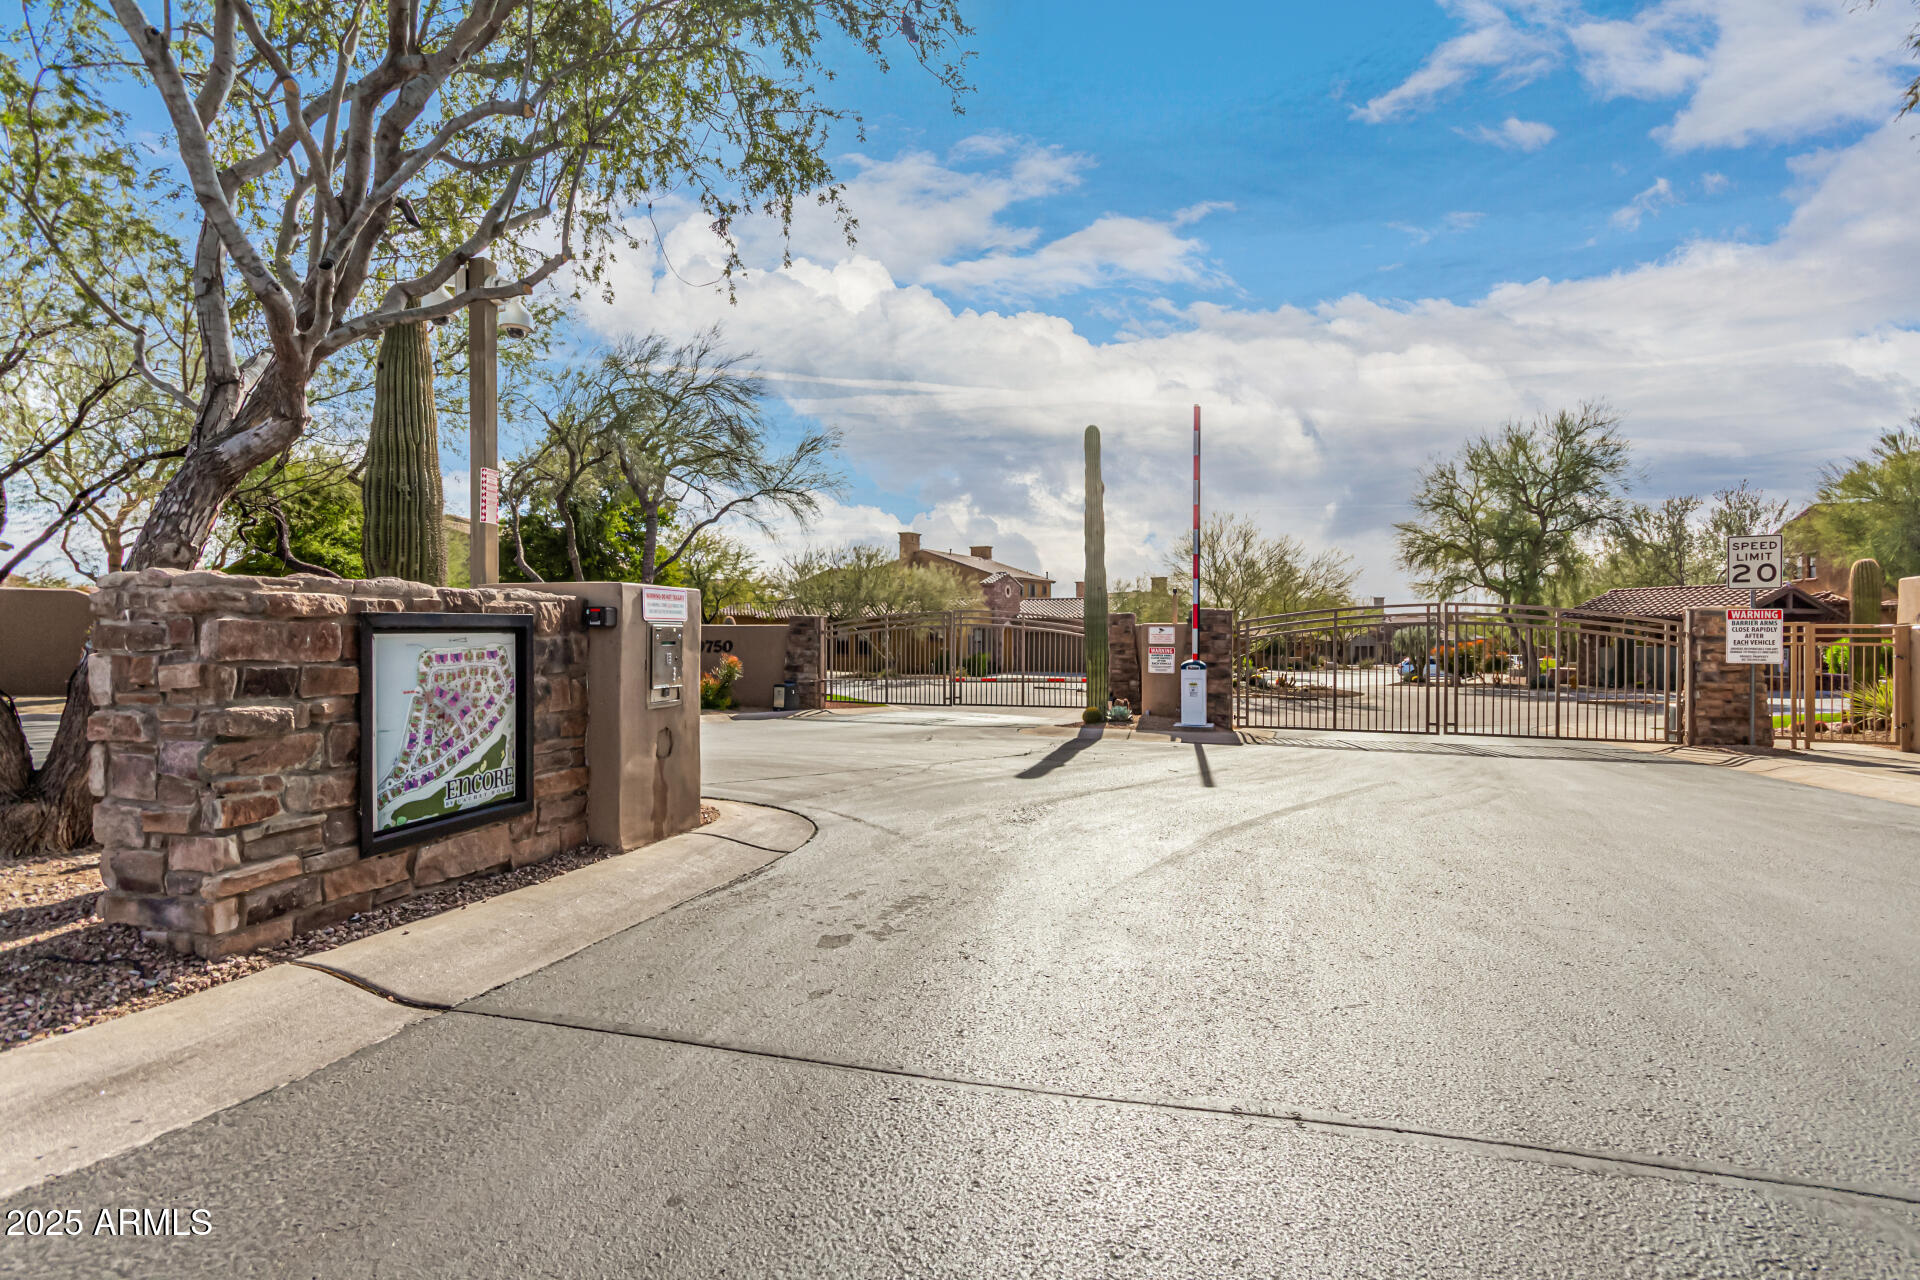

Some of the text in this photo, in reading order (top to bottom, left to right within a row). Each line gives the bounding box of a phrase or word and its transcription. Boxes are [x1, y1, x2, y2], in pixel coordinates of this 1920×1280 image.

[1732, 541, 1778, 550] SPEED
[1736, 552, 1773, 561] LIMIT
[1731, 563, 1777, 583] 20
[1731, 610, 1779, 619] WARNING
